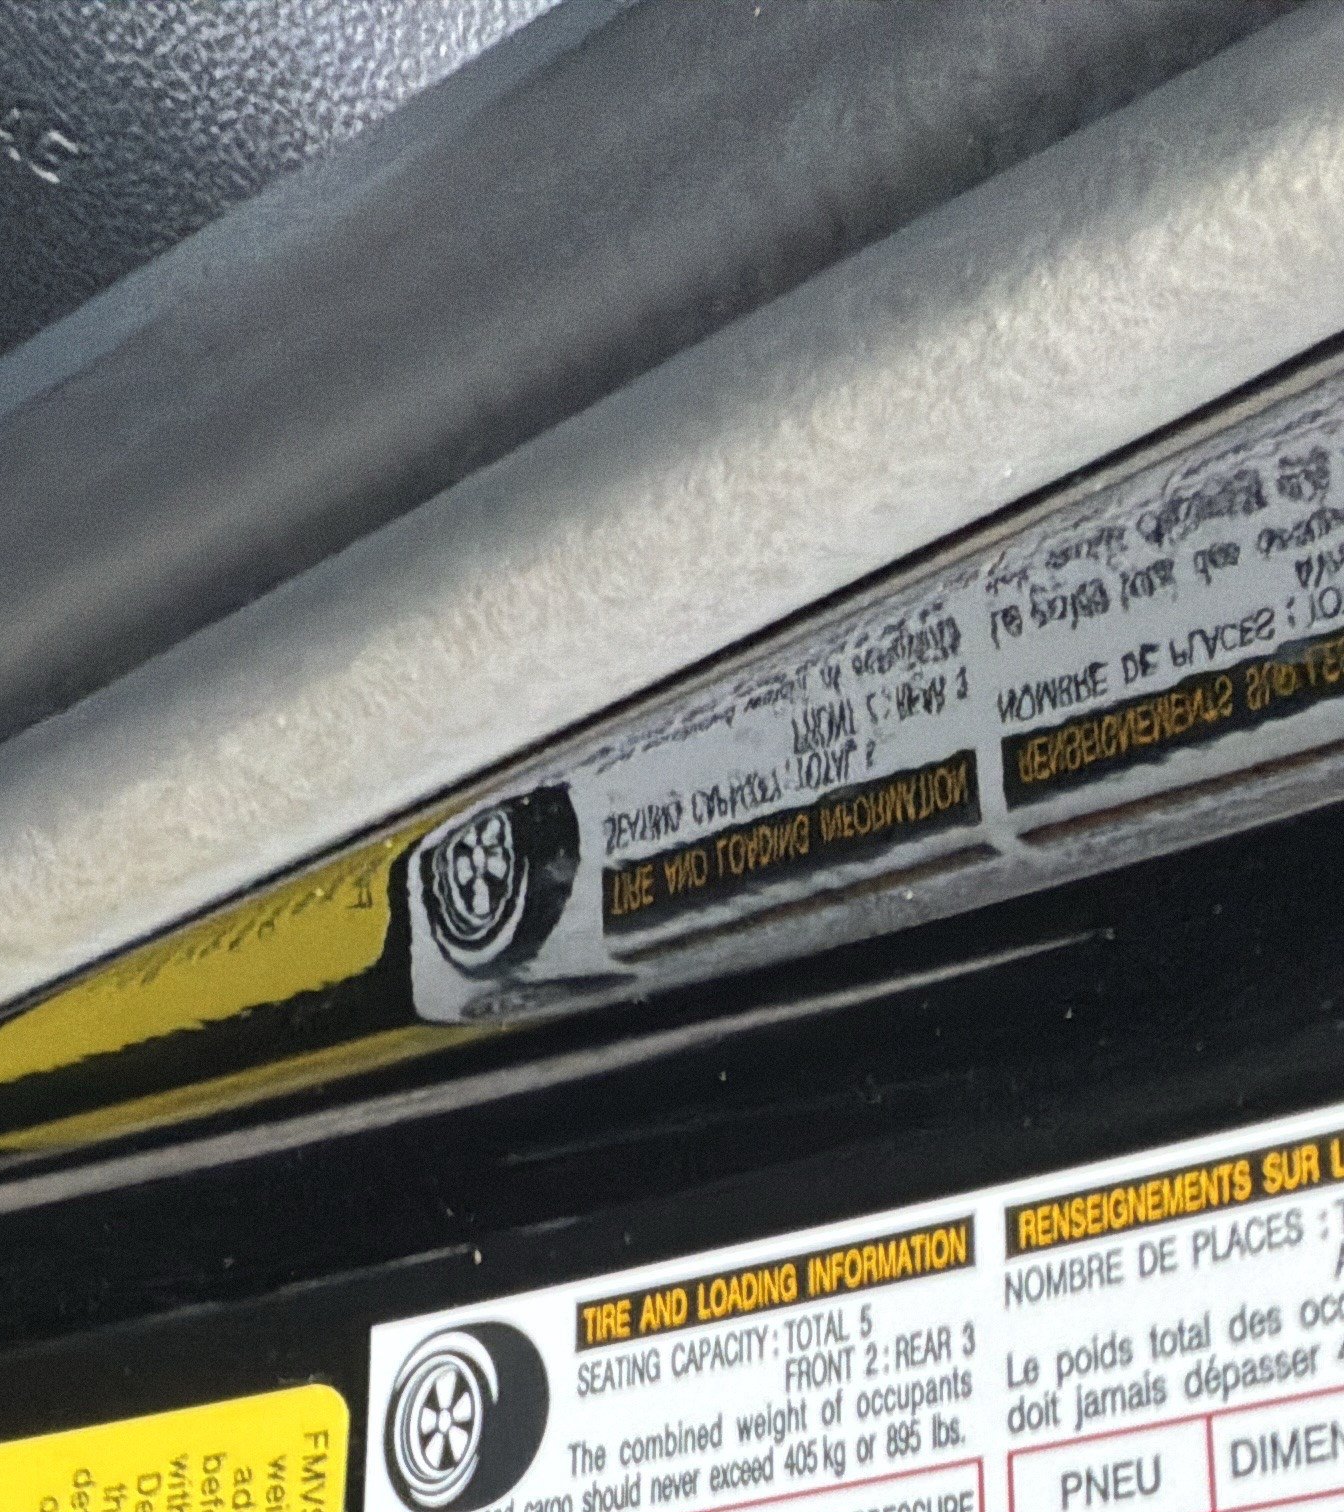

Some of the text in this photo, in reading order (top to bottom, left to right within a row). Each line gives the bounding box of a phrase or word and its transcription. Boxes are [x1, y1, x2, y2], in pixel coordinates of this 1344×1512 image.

[1017, 1158, 1253, 1248] RENSEIGNEMENTS
[1261, 1143, 1321, 1195] SUR
[582, 1226, 968, 1344] TIRE AND LOADING INFORMATION
[1005, 1353, 1040, 1391] Le
[1054, 1330, 1134, 1388] poids
[1147, 1309, 1211, 1361] total
[1226, 1303, 1283, 1345] des
[1005, 1390, 1061, 1436] doit
[1073, 1368, 1168, 1433] jamais
[1182, 1343, 1320, 1403] dépasser
[566, 1365, 973, 1477] The combined weight of occupants
[649, 1467, 700, 1504] never
[708, 1445, 774, 1494] exceed
[782, 1437, 818, 1477] 405
[821, 1434, 846, 1479] kg
[854, 1432, 877, 1465] or
[884, 1416, 922, 1460] 895
[930, 1412, 966, 1450] lbs.
[1059, 1453, 1161, 1512] PNEU
